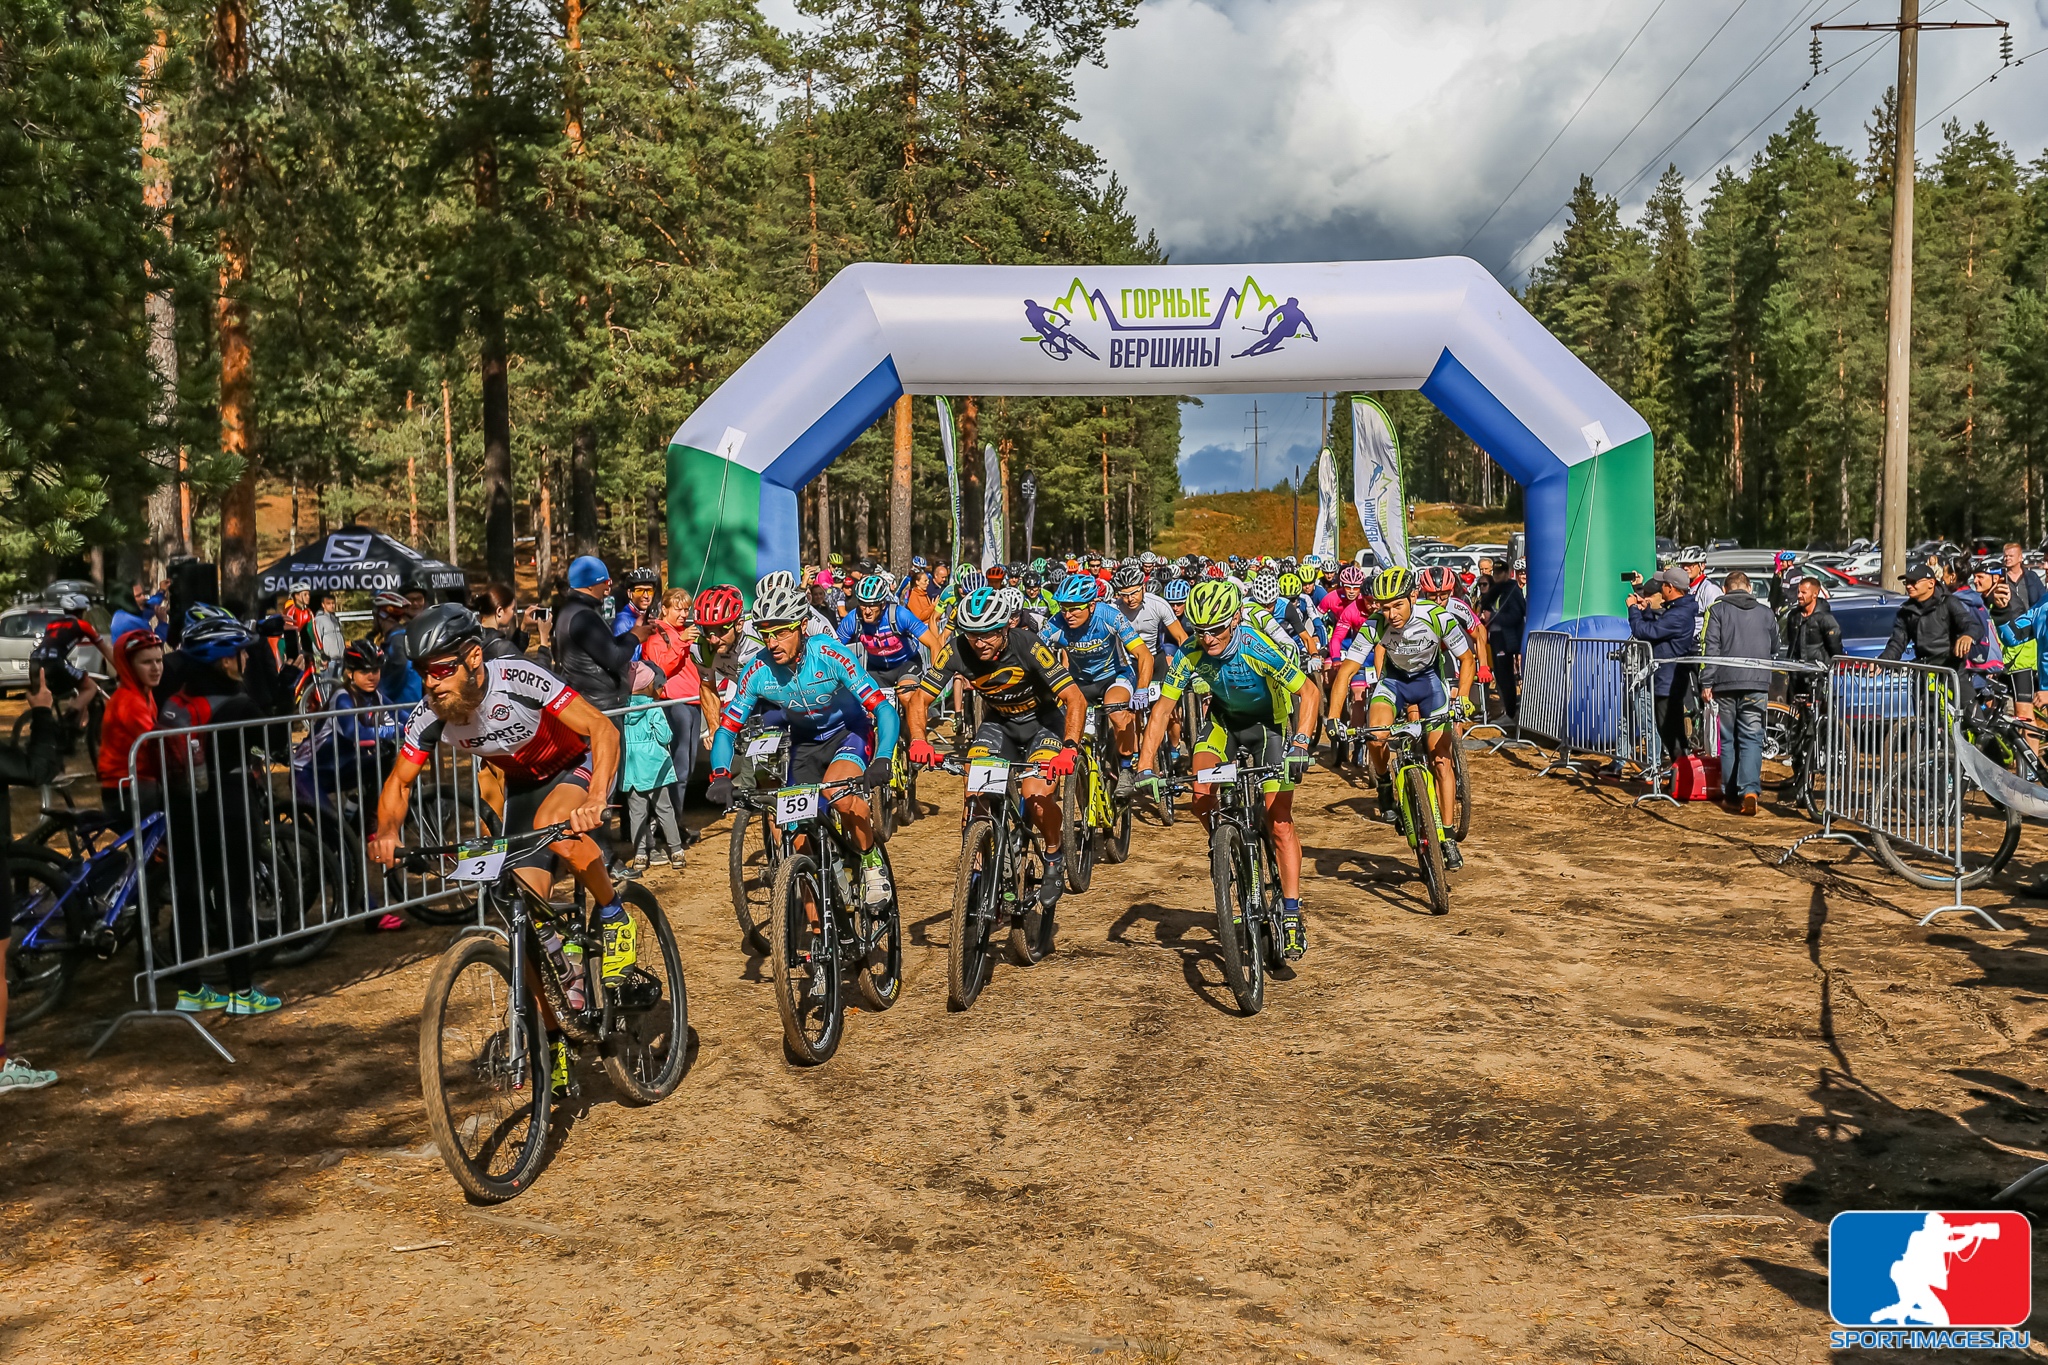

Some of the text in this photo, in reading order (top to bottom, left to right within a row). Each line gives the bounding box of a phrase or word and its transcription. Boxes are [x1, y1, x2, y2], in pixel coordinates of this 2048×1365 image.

[1121, 288, 1211, 319] ГОРНЫЕ
[1109, 337, 1221, 369] ВЕРШИНЫ
[500, 667, 552, 693] USPORTS
[458, 722, 526, 749] USPORTS
[504, 730, 534, 745] TEAM
[759, 739, 769, 750] 7
[983, 769, 992, 784] 1
[1211, 763, 1222, 775] 2
[785, 796, 808, 815] 59
[470, 860, 487, 876] 3
